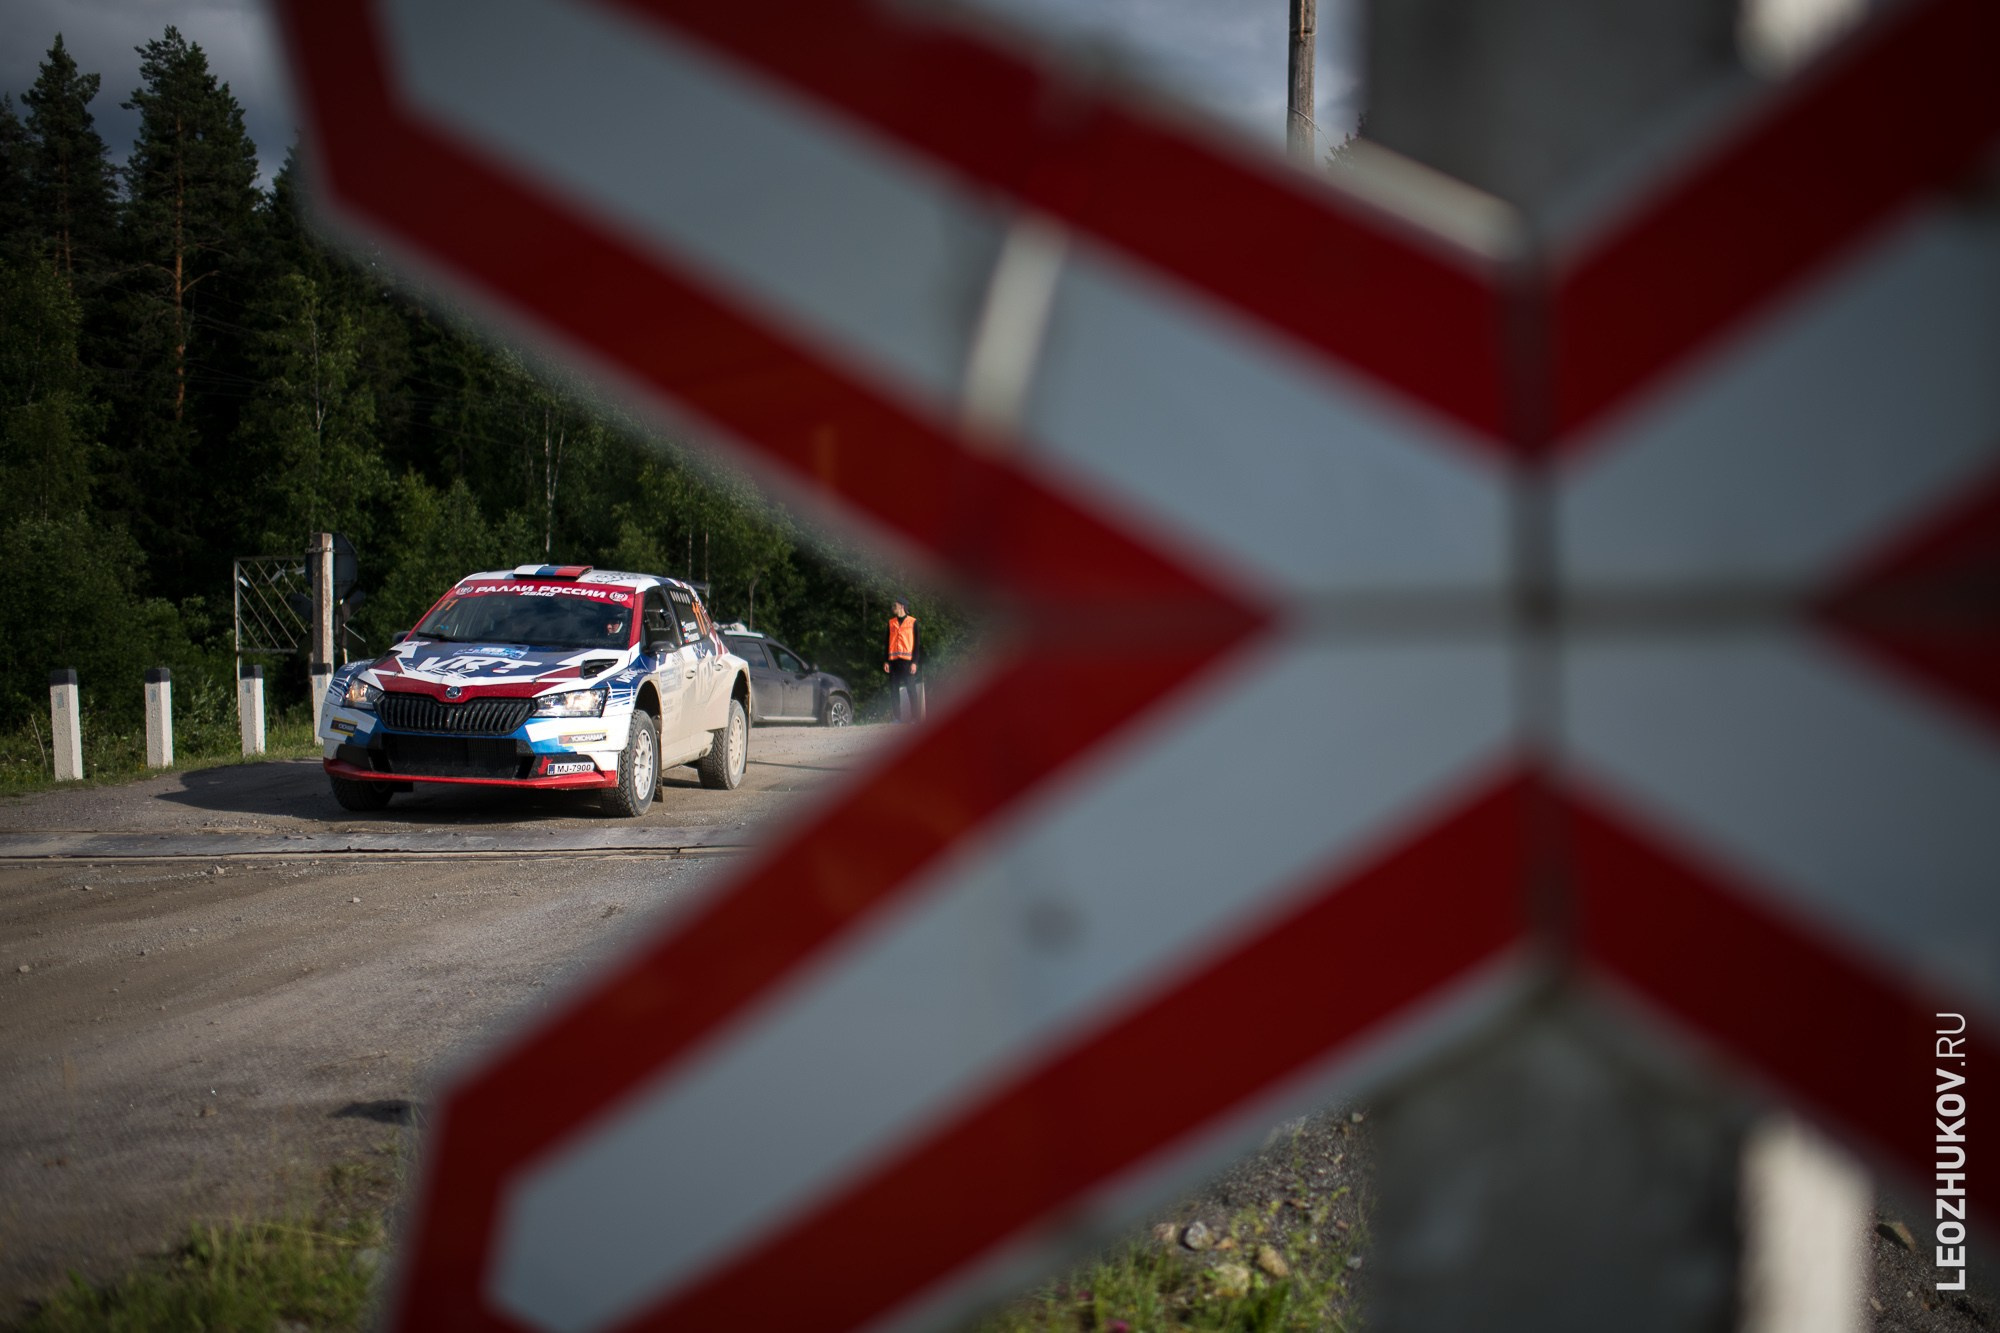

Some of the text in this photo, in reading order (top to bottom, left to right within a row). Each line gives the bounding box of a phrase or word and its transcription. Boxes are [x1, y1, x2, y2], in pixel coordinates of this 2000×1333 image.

[475, 585, 534, 593] РАЛЛИ
[539, 585, 606, 598] РОССИИ
[571, 733, 604, 742] YOKOHAMA
[557, 764, 591, 773] MJ-7900
